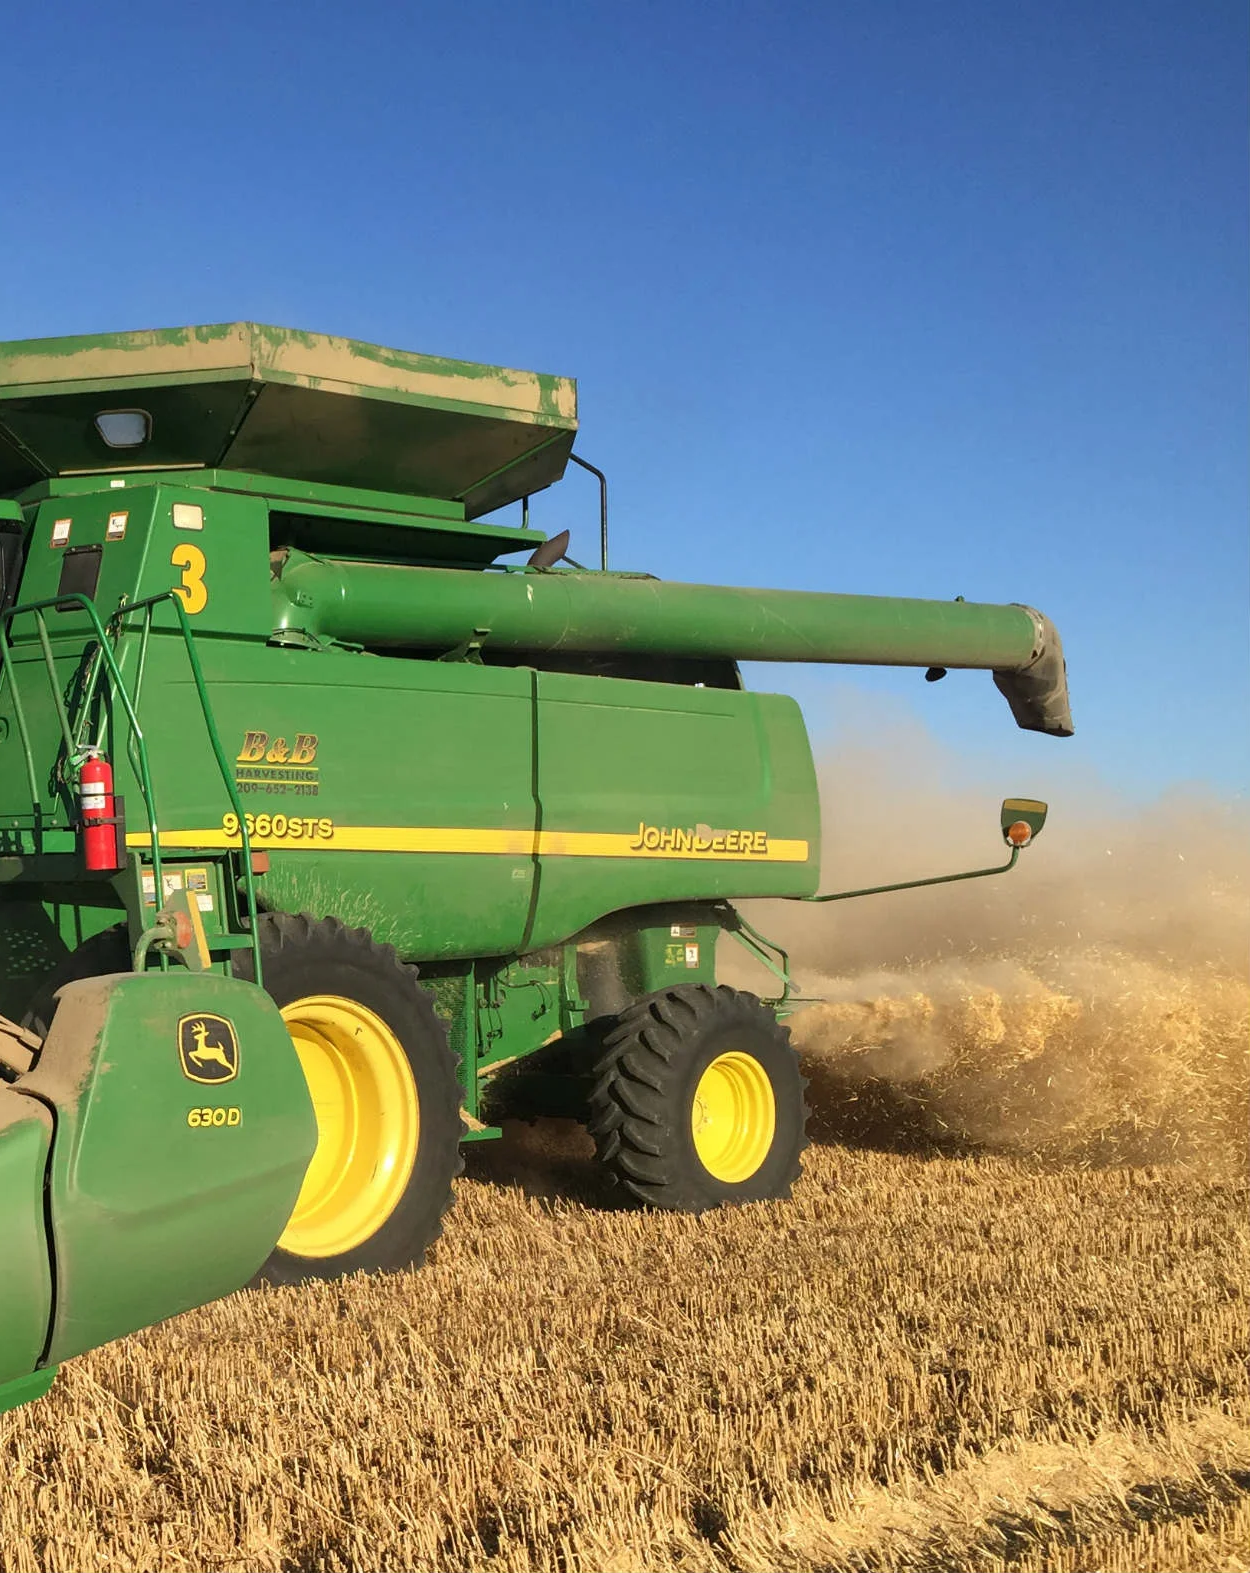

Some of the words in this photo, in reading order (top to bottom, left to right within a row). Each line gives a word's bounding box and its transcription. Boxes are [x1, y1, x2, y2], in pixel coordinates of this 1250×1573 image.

[171, 543, 208, 615] 3
[236, 731, 319, 764] B&B
[236, 769, 314, 781] HARVESTING
[630, 822, 692, 850] JOHN
[694, 823, 767, 853] DEERE
